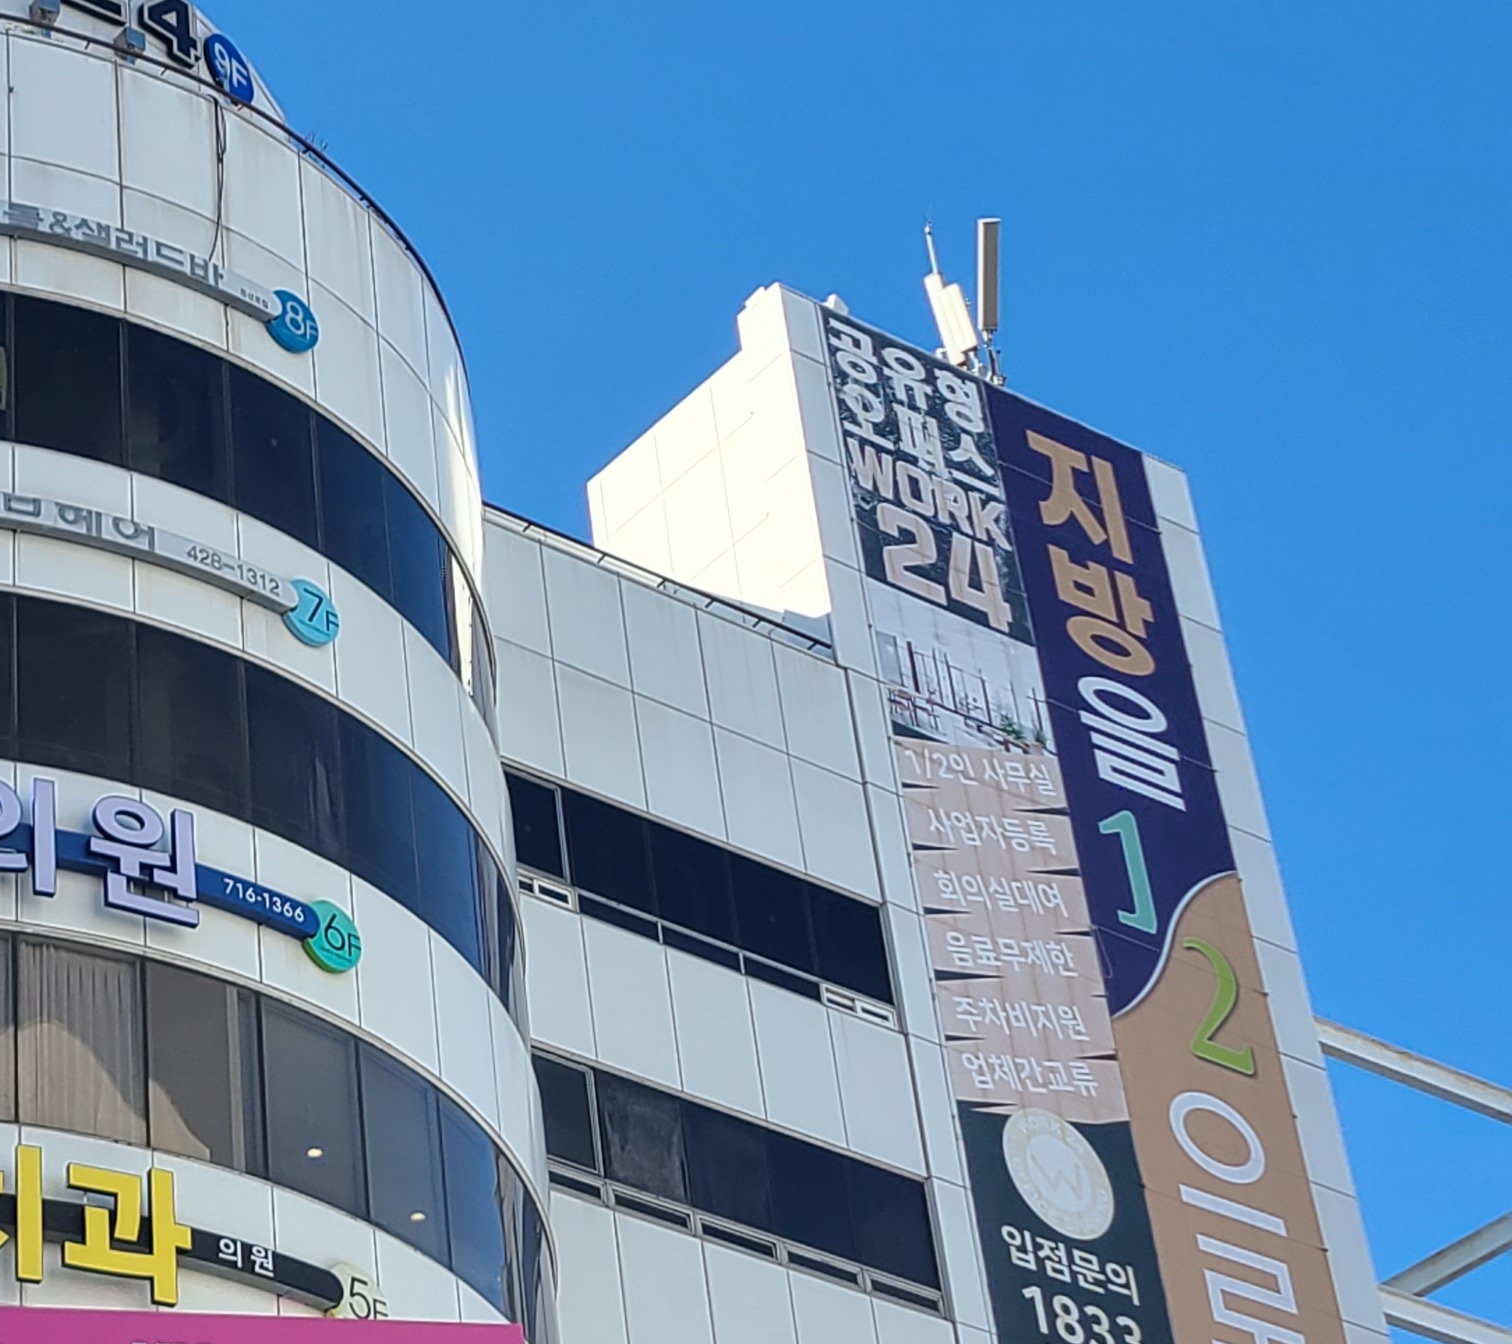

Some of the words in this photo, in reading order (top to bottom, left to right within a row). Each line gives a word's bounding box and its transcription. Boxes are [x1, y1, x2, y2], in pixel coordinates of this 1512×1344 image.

[285, 300, 319, 343] 8F
[827, 316, 986, 434] 공유형
[838, 382, 1003, 498] 오피스
[844, 437, 1014, 553] WORK
[185, 544, 281, 597] 428-1312
[876, 502, 1014, 632] 24
[301, 587, 341, 632] 7F
[1025, 428, 1187, 813] 지방을
[904, 747, 979, 787] 1/2인
[982, 757, 1057, 797] 사무실
[927, 807, 1057, 856] 사업자등록
[932, 869, 1069, 919] 회의실대여
[324, 913, 362, 957] 6F
[945, 930, 1079, 977] 음료무제한
[953, 996, 1091, 1042] 주차비지원
[961, 1051, 1100, 1098] 업체간교류
[217, 1238, 275, 1278] 의원
[1000, 1224, 1141, 1307] 입점문의
